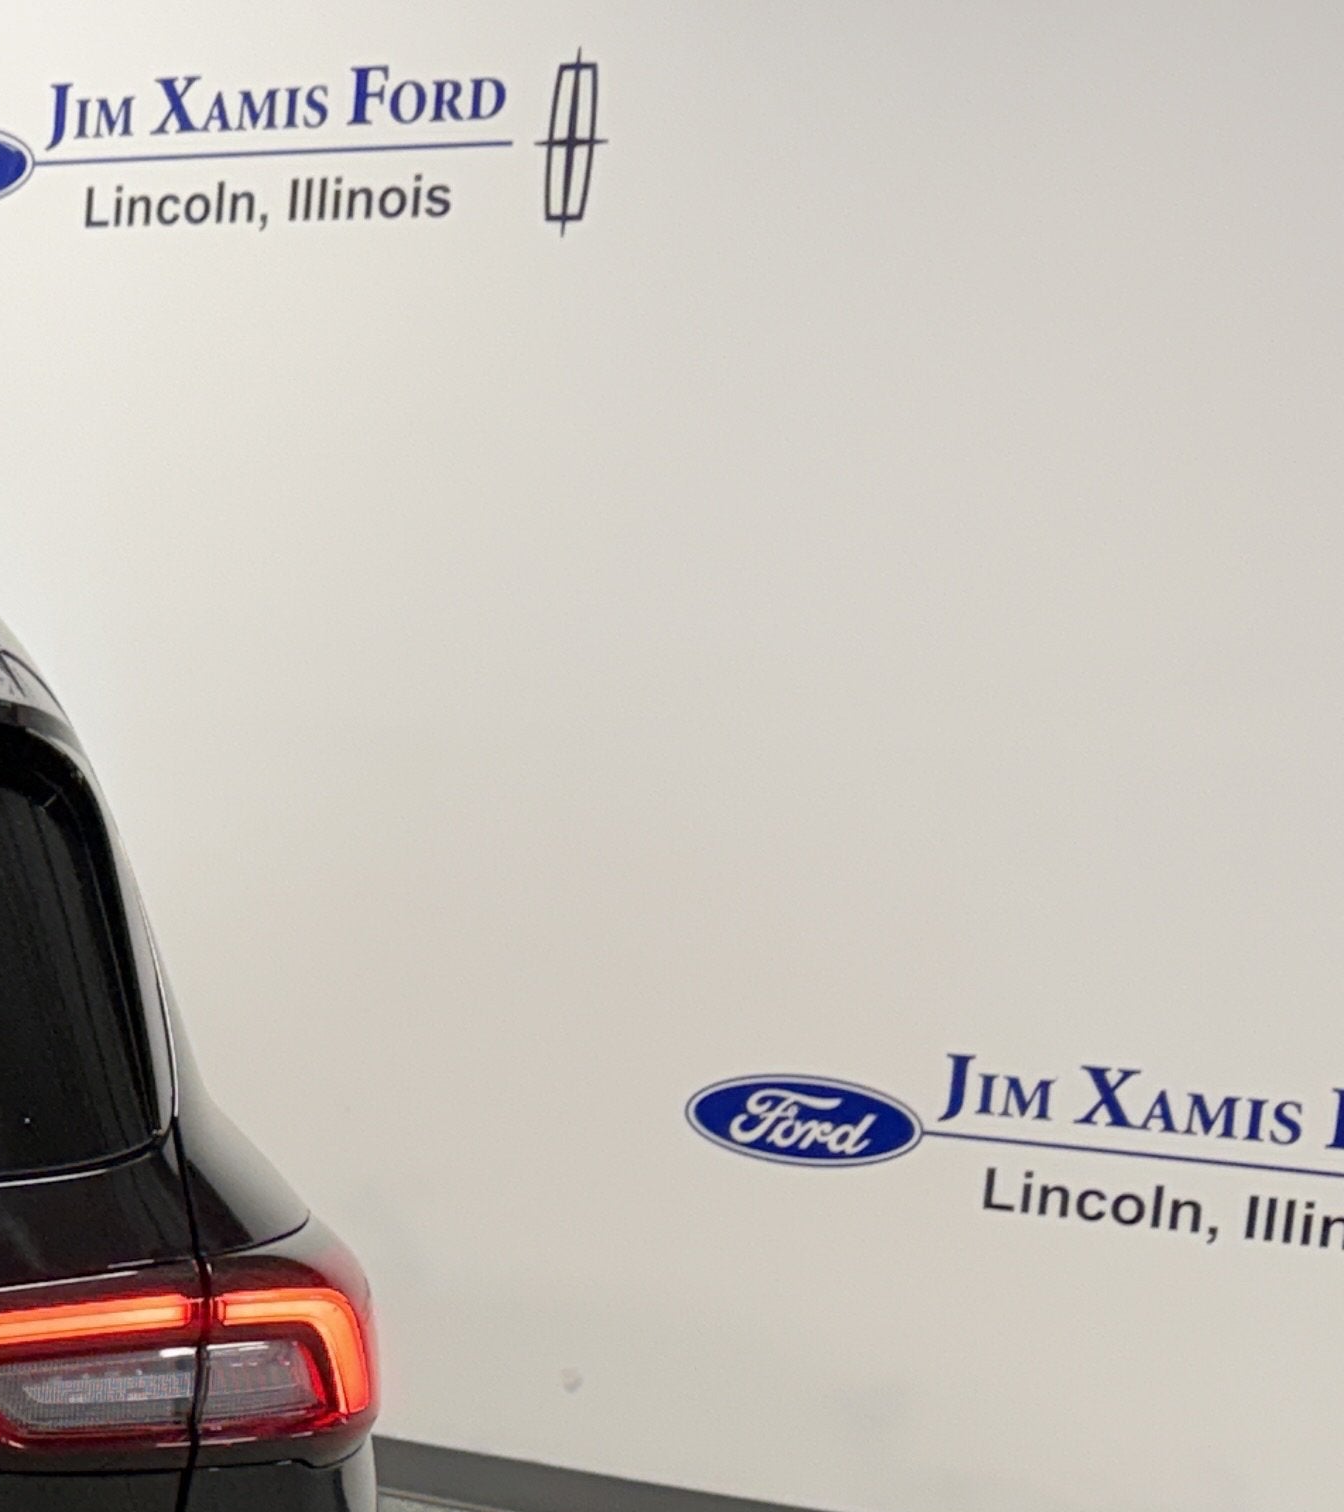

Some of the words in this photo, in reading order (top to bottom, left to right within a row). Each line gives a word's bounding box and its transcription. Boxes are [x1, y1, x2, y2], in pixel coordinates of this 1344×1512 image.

[45, 81, 137, 151] JIM
[154, 75, 329, 136] XAMIS
[347, 64, 506, 127] FORD
[83, 179, 270, 230] Lincoln,
[287, 173, 452, 223] Illinois
[729, 1087, 877, 1157] Ford
[937, 1053, 1057, 1123] JIM
[1073, 1065, 1303, 1146] XAMIS
[981, 1167, 1219, 1244] Lincoln,
